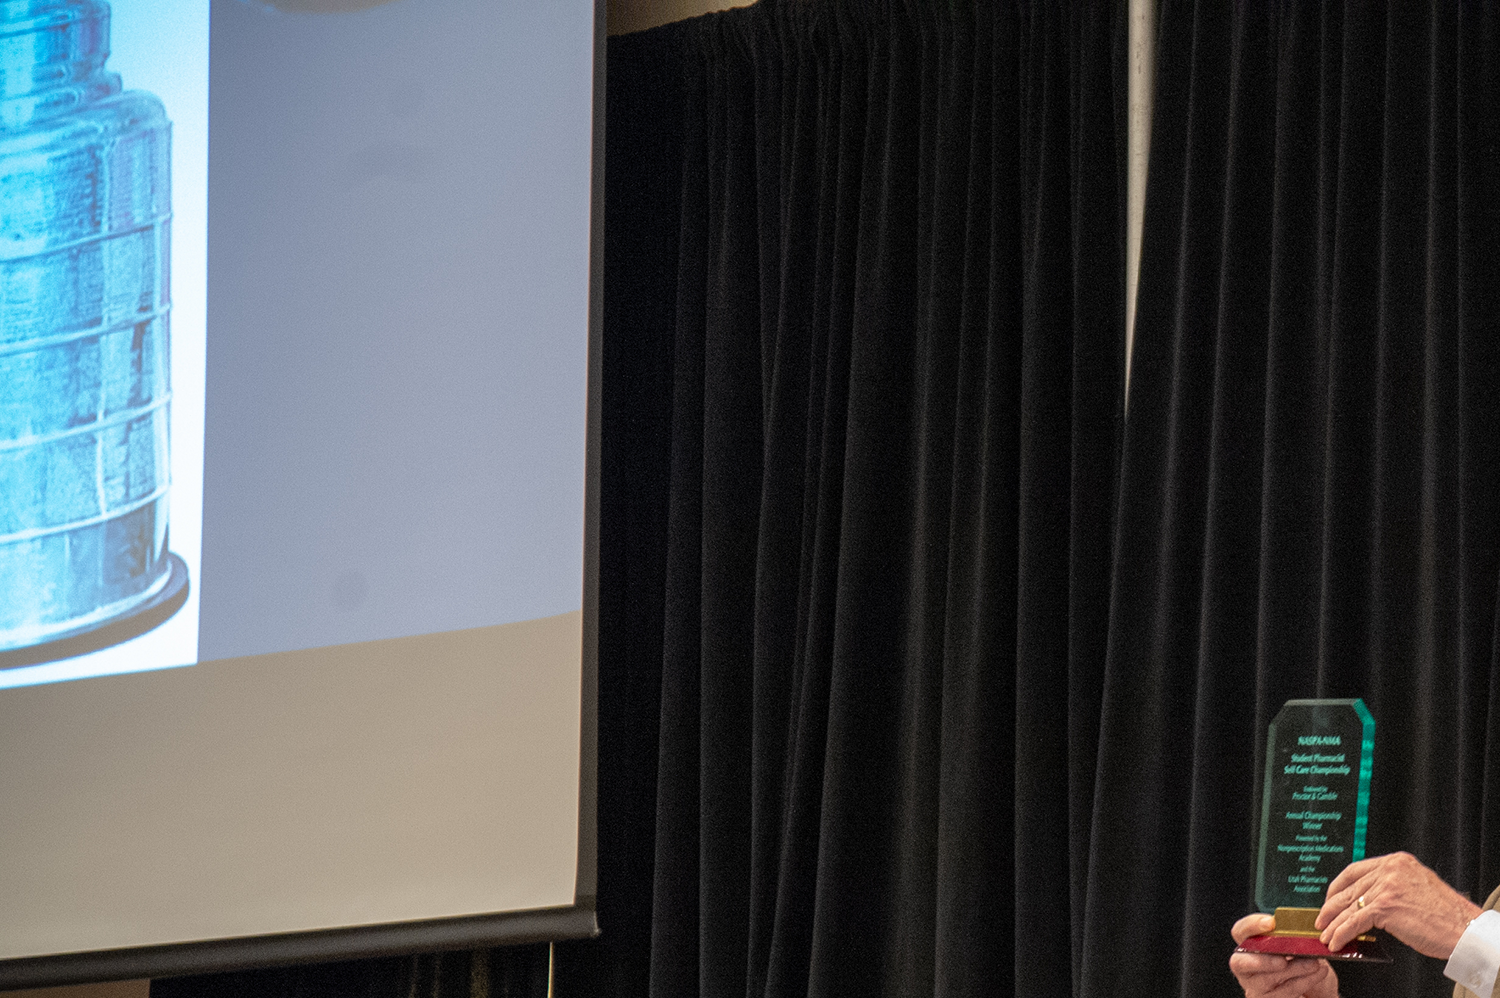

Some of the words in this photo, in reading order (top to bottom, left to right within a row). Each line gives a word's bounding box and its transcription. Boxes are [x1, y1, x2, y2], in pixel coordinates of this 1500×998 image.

[1291, 753, 1313, 762] Student
[1314, 753, 1345, 762] Pharmacist
[1310, 764, 1351, 776] Championship
[1285, 811, 1304, 819] Annual
[1305, 811, 1342, 821] Championship
[1302, 822, 1323, 830] Winner
[1299, 853, 1321, 863] Academy
